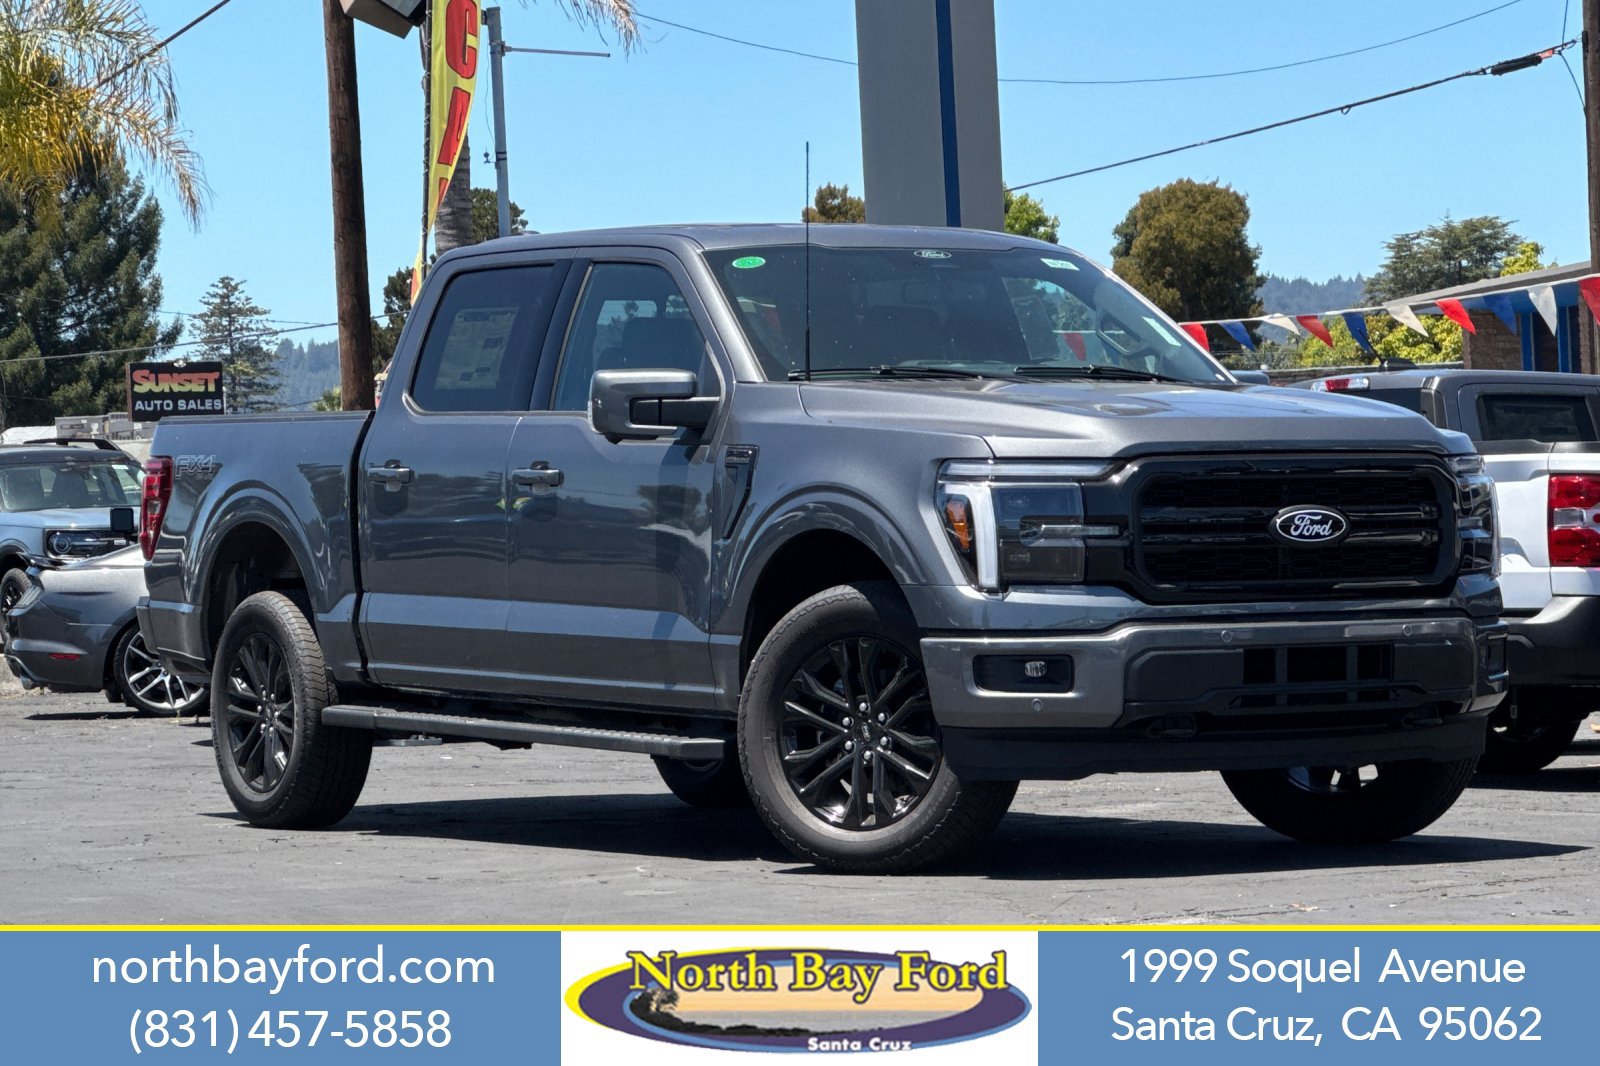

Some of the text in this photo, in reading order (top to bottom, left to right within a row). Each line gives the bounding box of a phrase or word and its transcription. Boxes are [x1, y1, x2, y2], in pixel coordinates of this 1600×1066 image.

[132, 369, 220, 394] SUNSET
[135, 398, 222, 411] AUTO SALES
[175, 454, 217, 480] FX4
[1290, 514, 1333, 536] Ford
